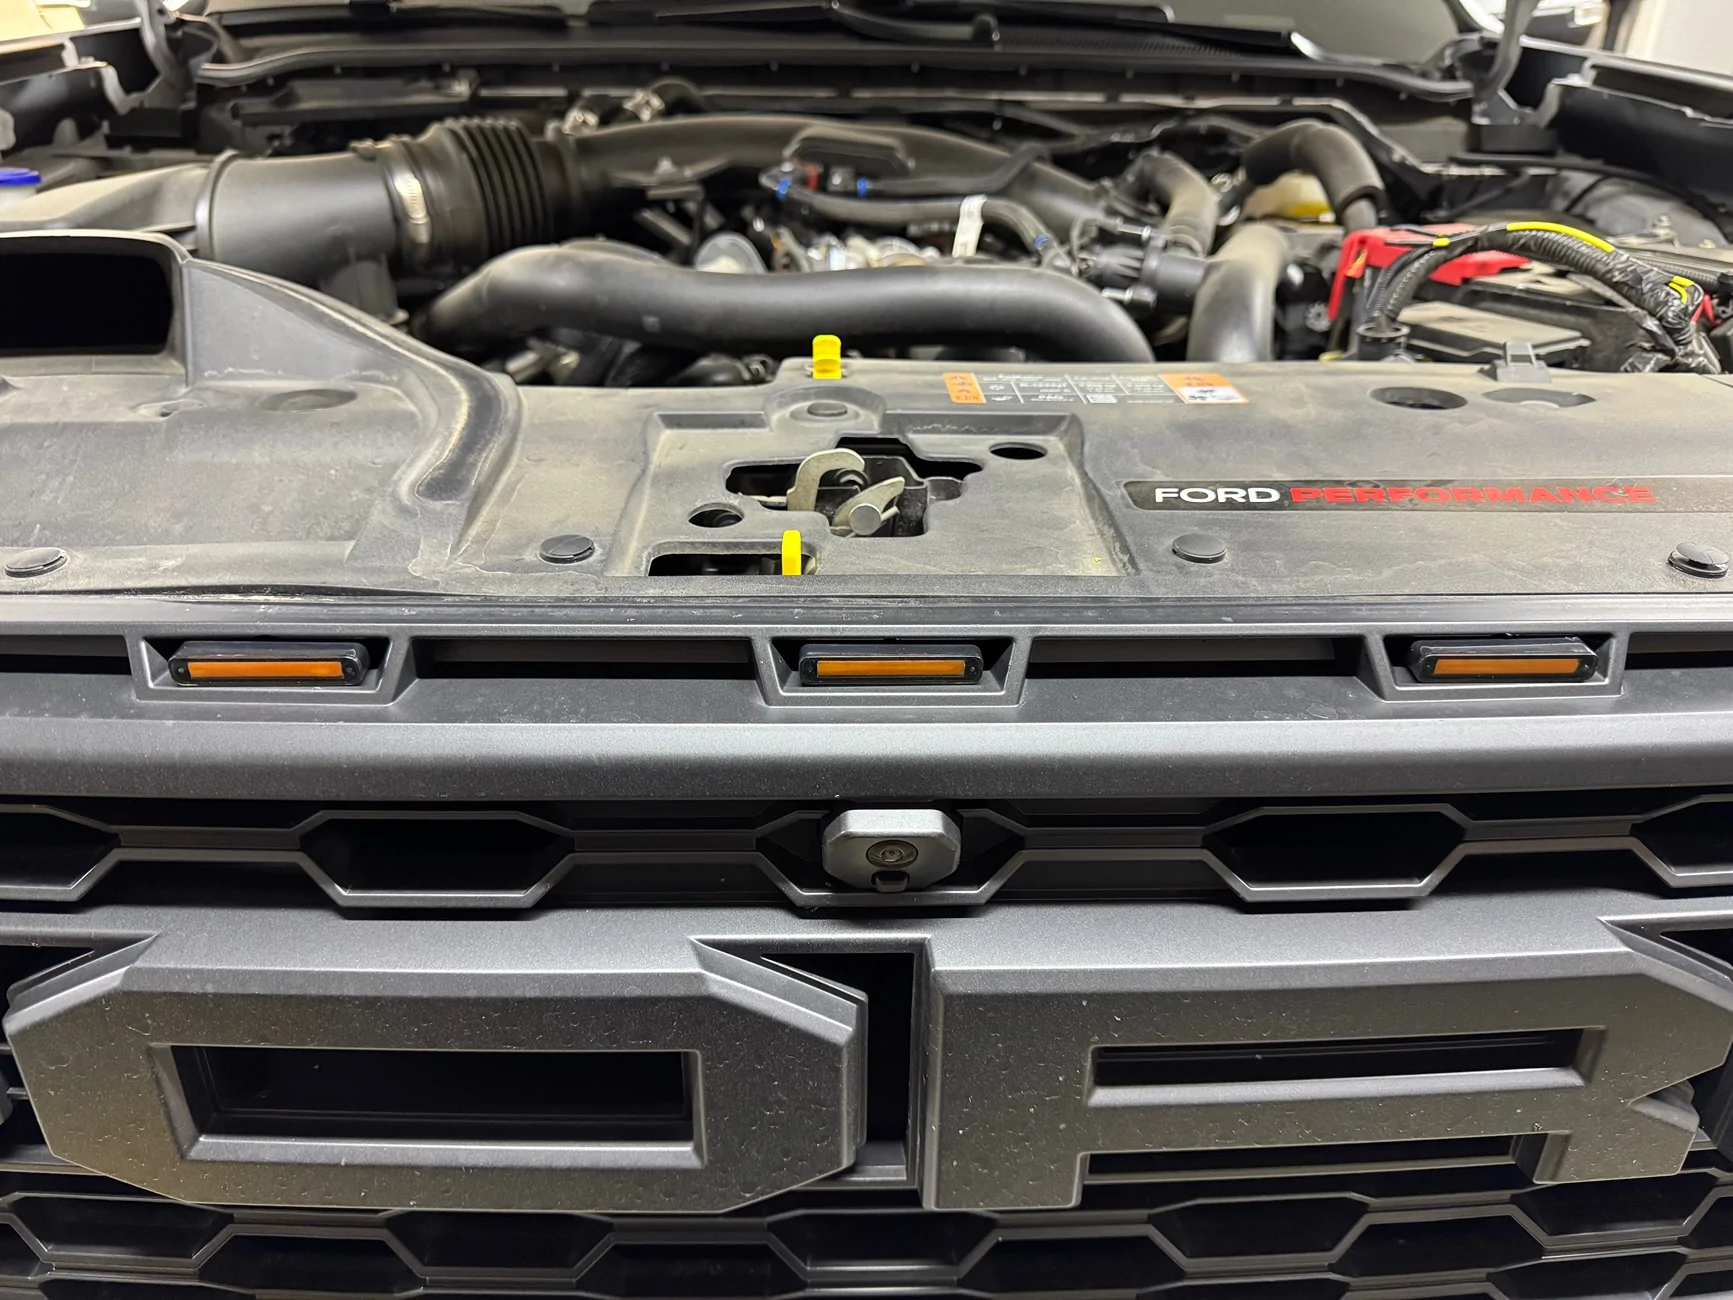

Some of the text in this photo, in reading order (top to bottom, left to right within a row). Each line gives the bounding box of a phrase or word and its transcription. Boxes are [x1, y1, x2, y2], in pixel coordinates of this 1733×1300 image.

[1154, 486, 1658, 503] FORD PERFORMANCE
[0, 935, 1733, 1213] OR
